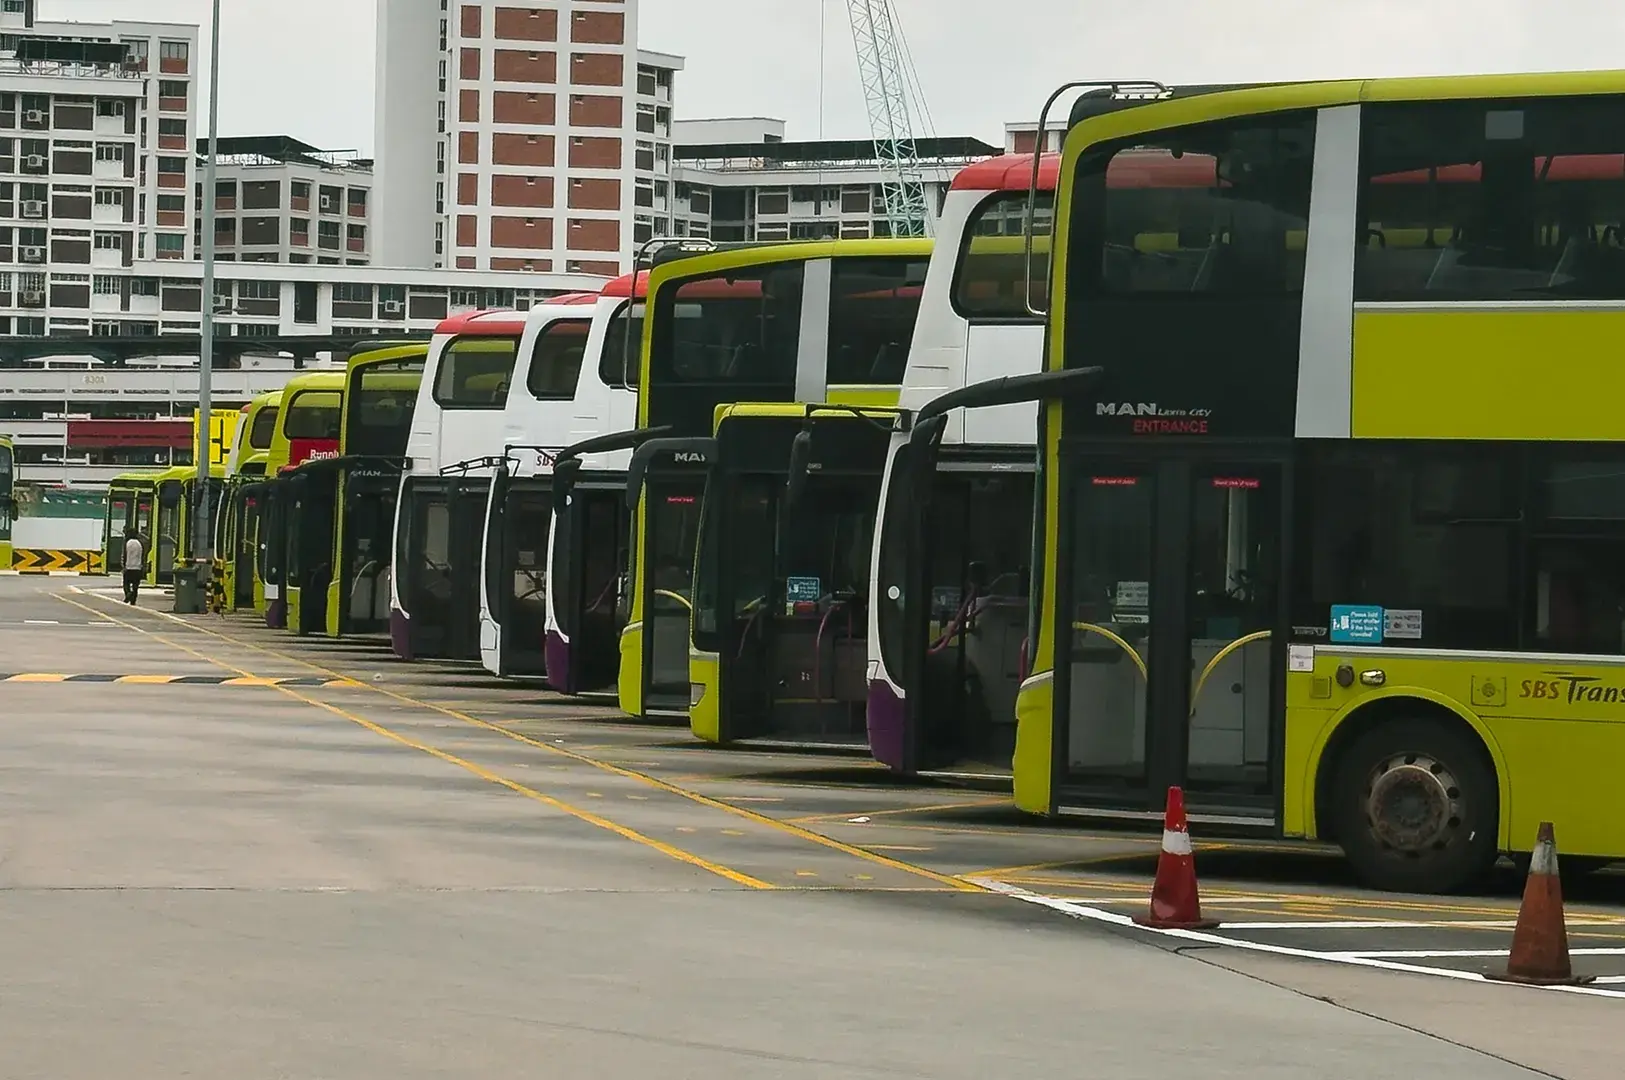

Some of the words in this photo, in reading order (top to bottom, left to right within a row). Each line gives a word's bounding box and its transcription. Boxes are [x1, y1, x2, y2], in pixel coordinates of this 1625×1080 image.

[1096, 402, 1157, 416] MAN
[1133, 419, 1208, 433] ENTRANCE
[1519, 679, 1560, 700] SBS
